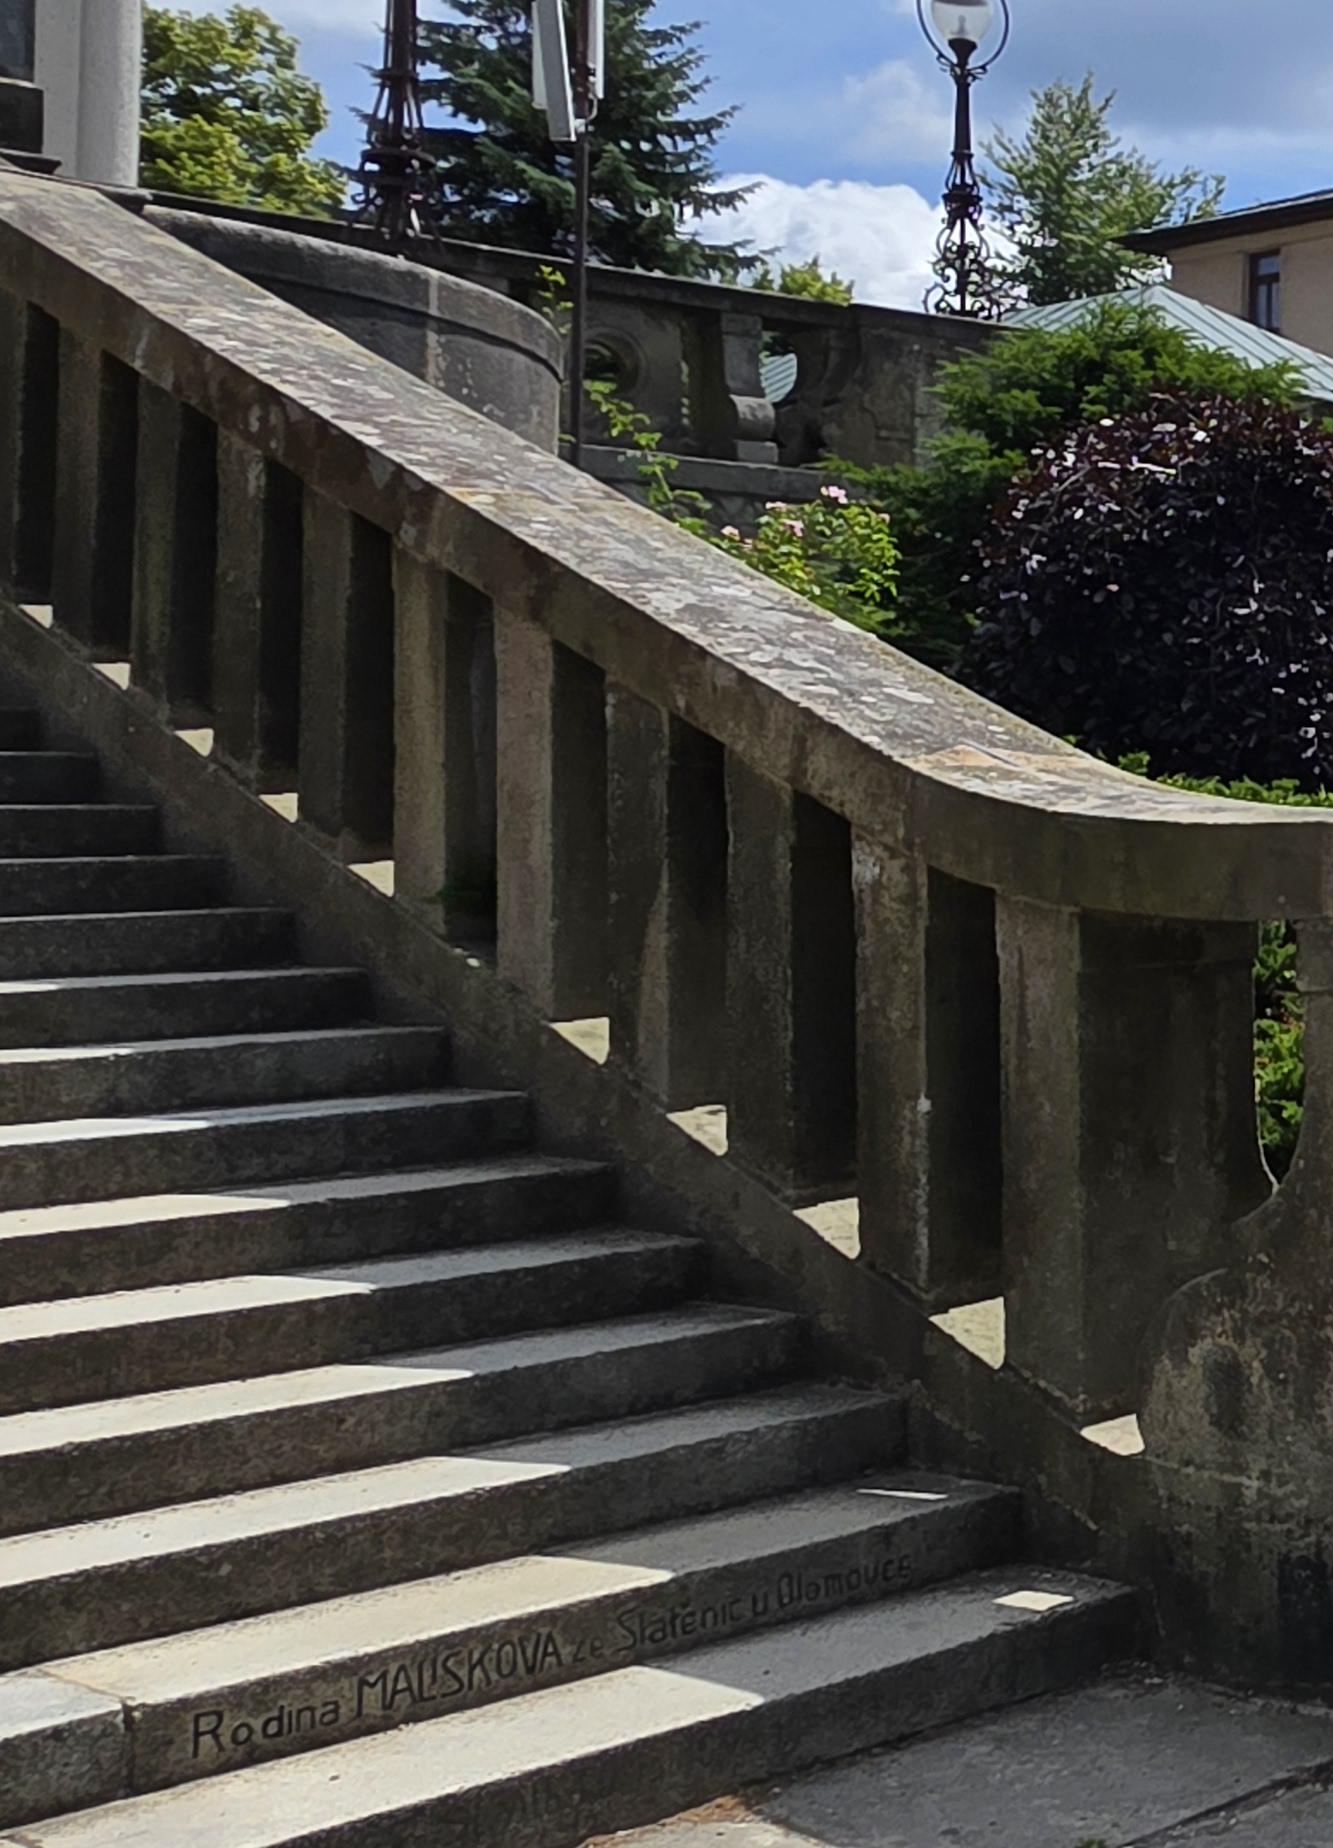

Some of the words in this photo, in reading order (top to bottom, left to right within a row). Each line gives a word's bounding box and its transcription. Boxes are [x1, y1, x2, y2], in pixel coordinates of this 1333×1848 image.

[191, 1700, 341, 1759] Rodina
[573, 1636, 604, 1664] ze
[752, 1591, 769, 1617] u
